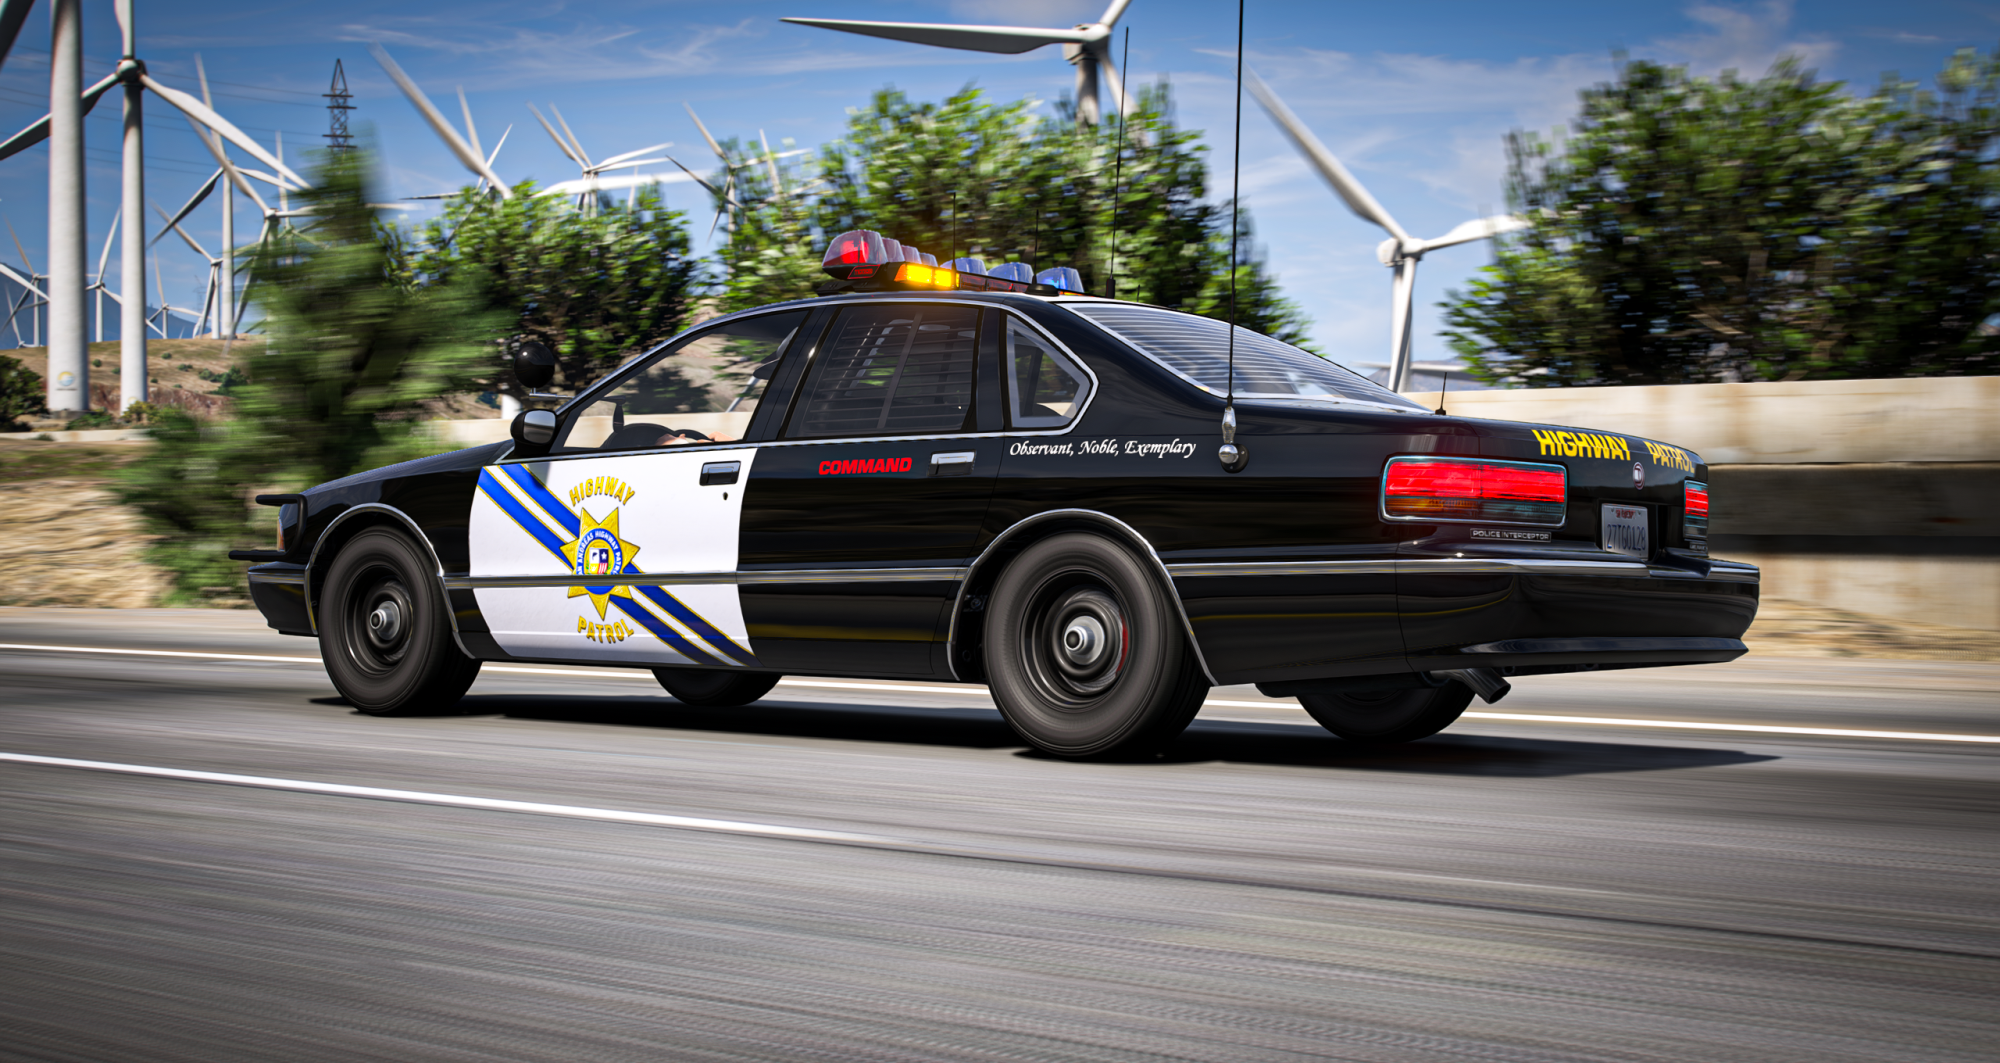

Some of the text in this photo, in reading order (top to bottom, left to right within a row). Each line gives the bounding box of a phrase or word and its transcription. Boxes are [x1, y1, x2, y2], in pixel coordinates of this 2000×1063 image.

[1009, 438, 1196, 459] Observant, Noble, Exemplary
[1531, 429, 1695, 474] HIGHWAY PATROL
[818, 457, 913, 475] COMMAND
[569, 476, 635, 507] HIGHWAY
[577, 532, 594, 564] ANDREAS
[594, 530, 619, 550] HIGHWAY
[1473, 530, 1549, 540] POLICE INTERCEPTOR
[577, 615, 634, 644] PATROL
